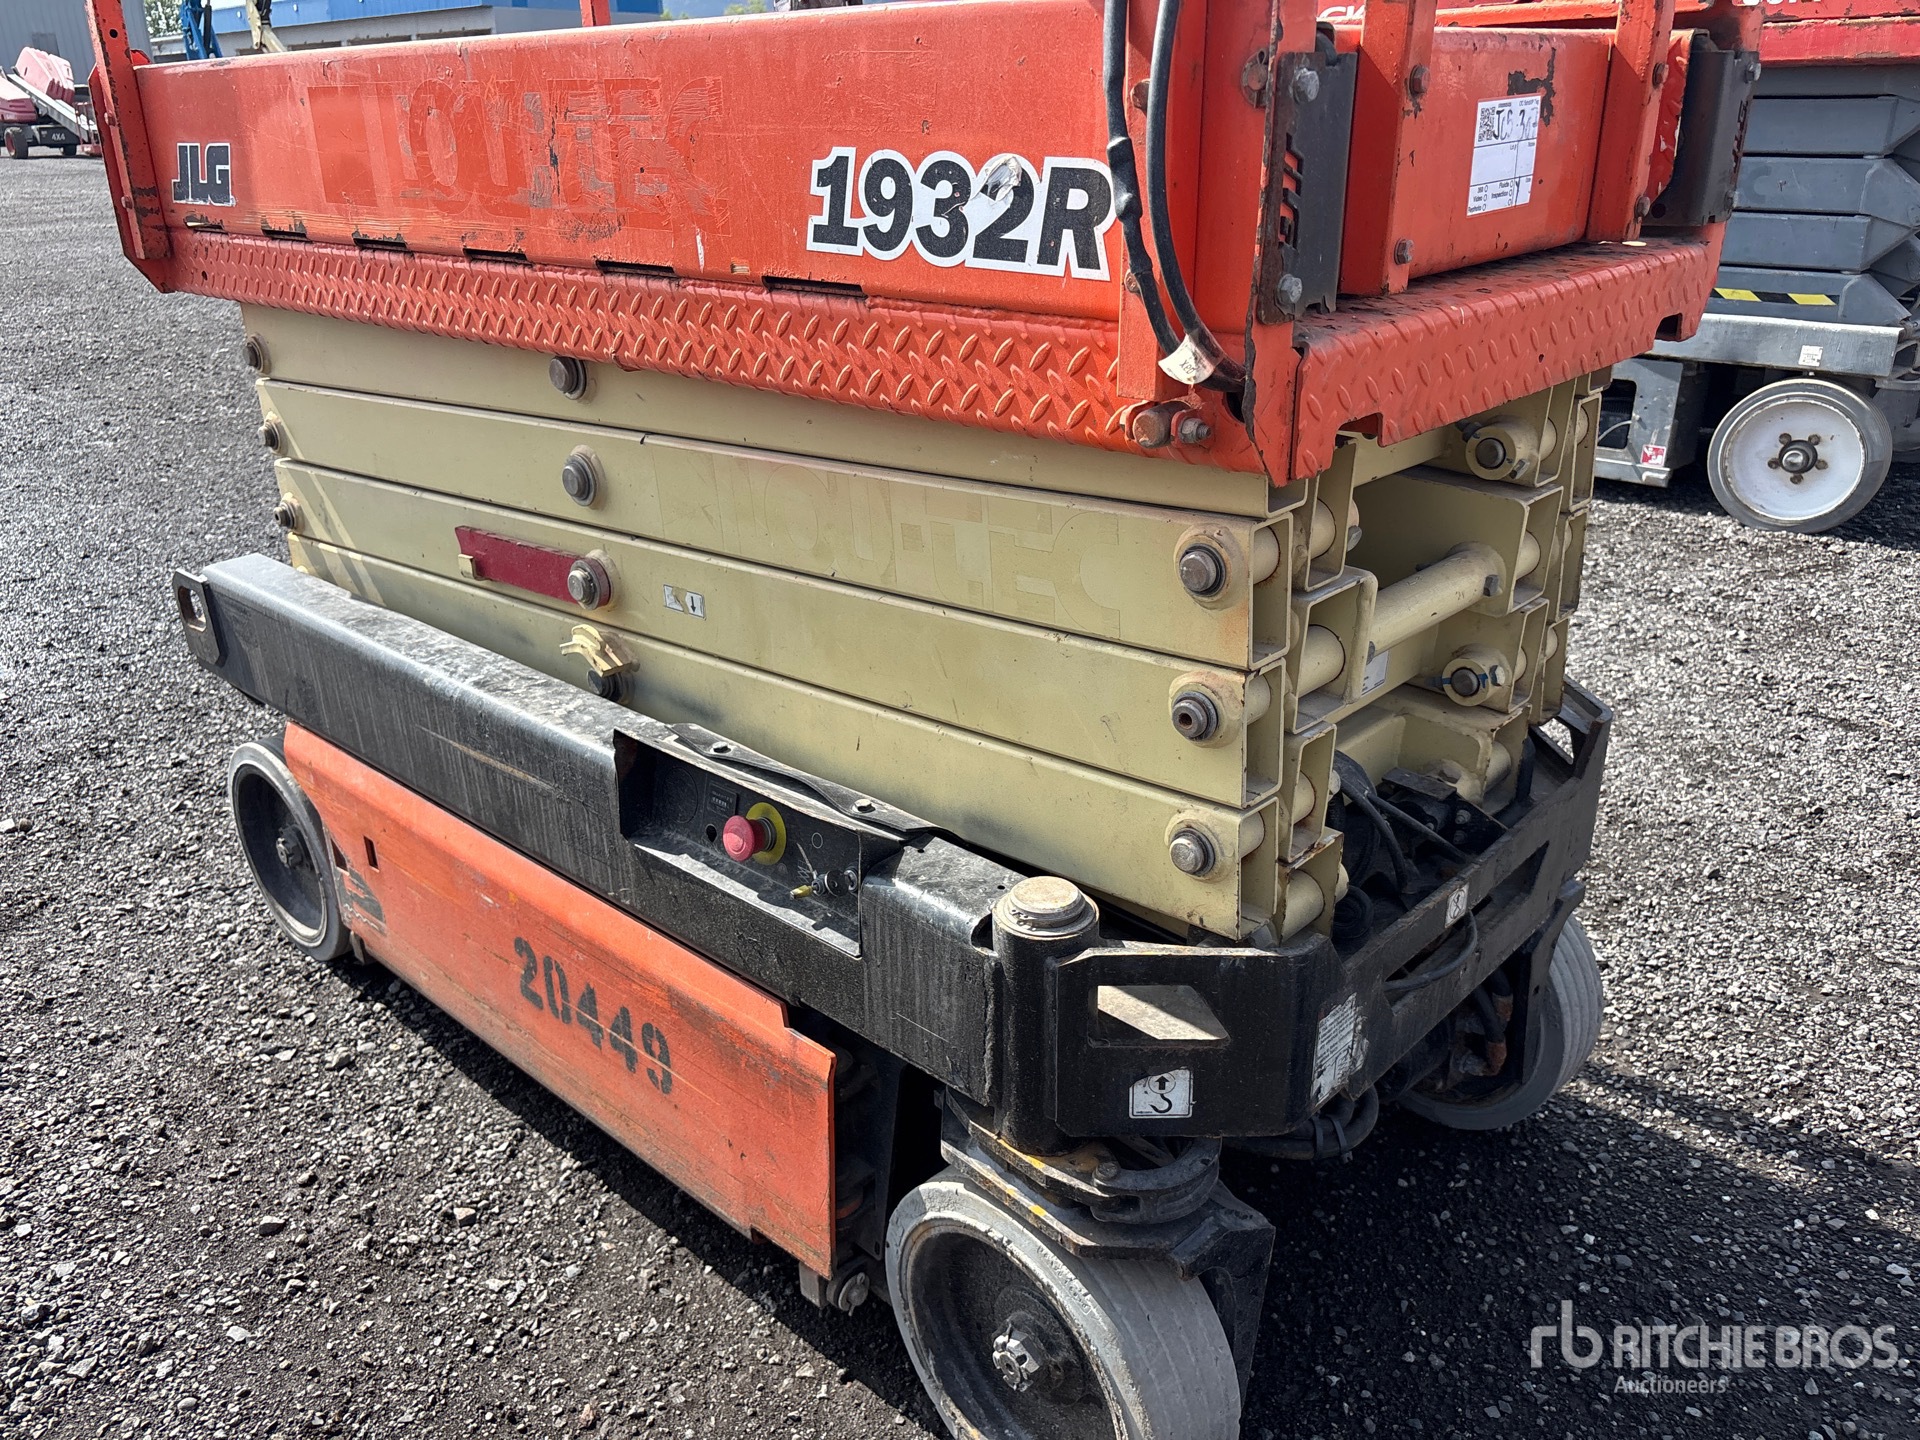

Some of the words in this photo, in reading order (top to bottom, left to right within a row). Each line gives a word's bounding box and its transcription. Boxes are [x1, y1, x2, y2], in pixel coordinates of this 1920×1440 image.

[51, 133, 66, 141] 4X4
[172, 143, 233, 206] JLG
[807, 148, 1113, 278] 1932R
[514, 936, 673, 1095] 20449
